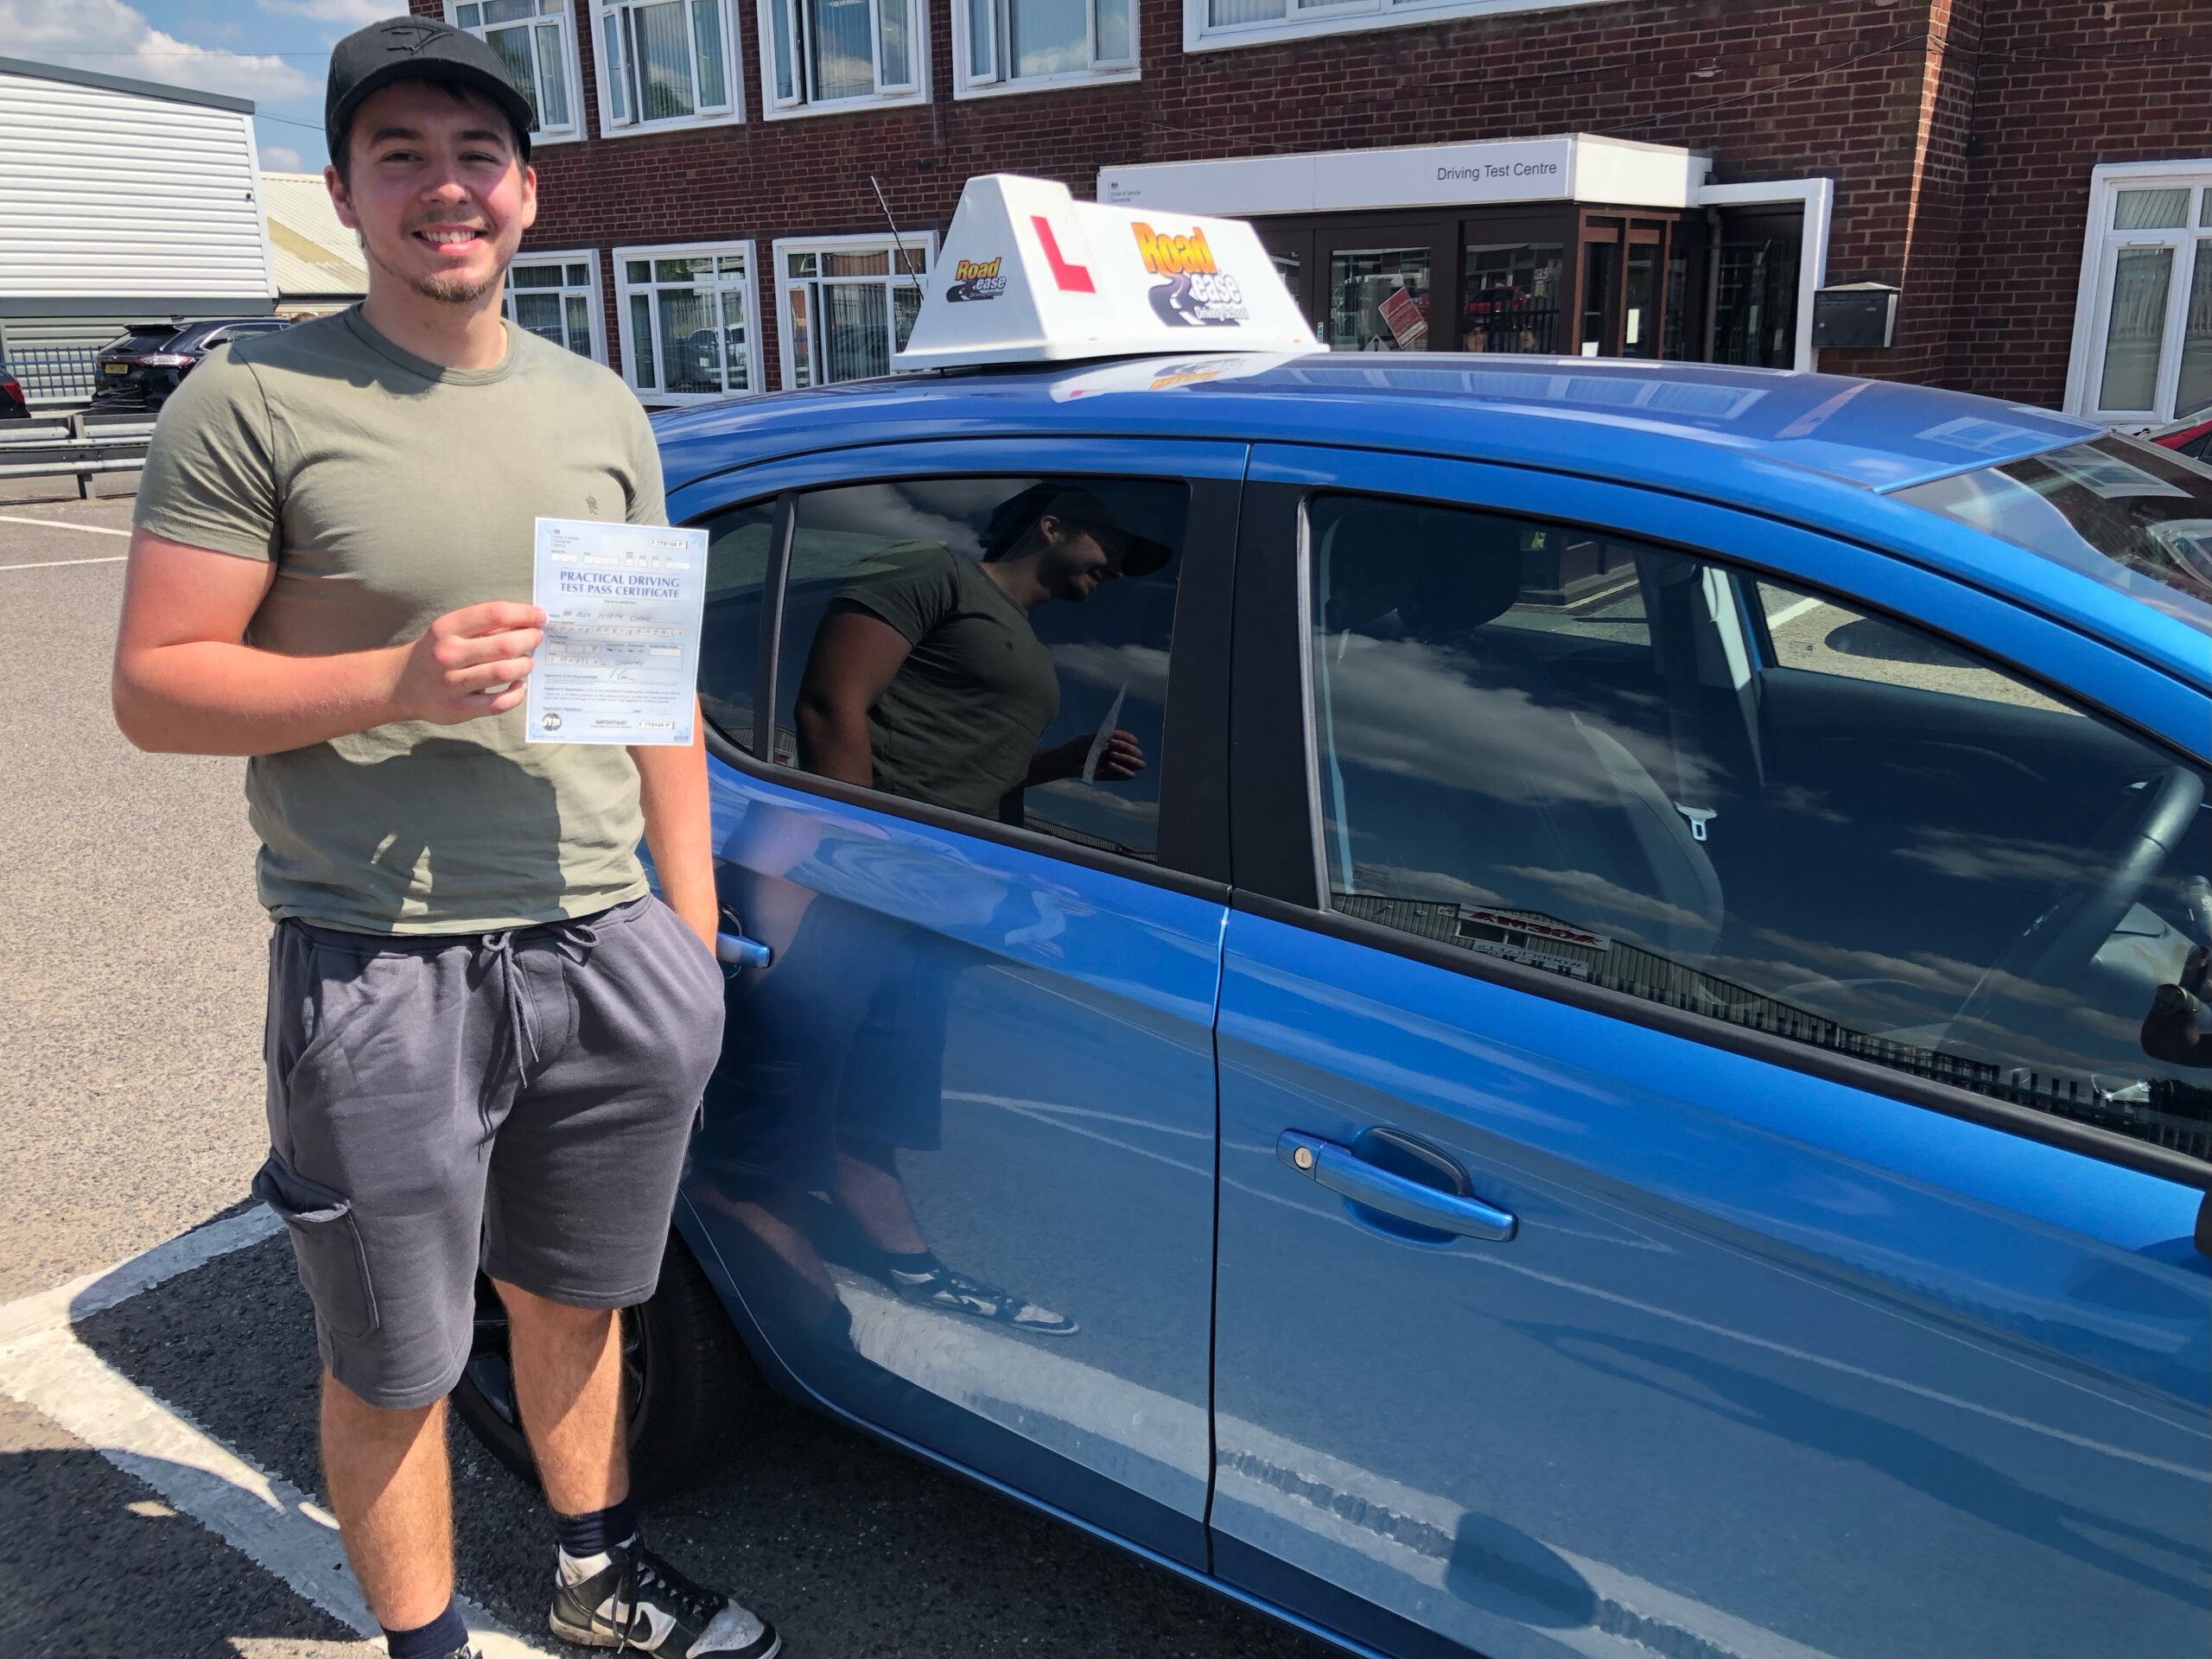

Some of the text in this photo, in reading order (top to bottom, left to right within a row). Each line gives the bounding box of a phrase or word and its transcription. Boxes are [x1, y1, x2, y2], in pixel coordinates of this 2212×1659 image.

[1437, 162, 1557, 181] Driving Test Centre
[1029, 215, 1096, 294] L
[1129, 221, 1218, 275] Road
[955, 257, 1001, 282] Road
[976, 276, 1007, 290] ease
[1190, 273, 1243, 303] ease
[1193, 305, 1225, 321] Driving
[560, 571, 680, 588] PRACTICAL DRIVING
[561, 582, 679, 598] TEST PASS CERTIFICATE
